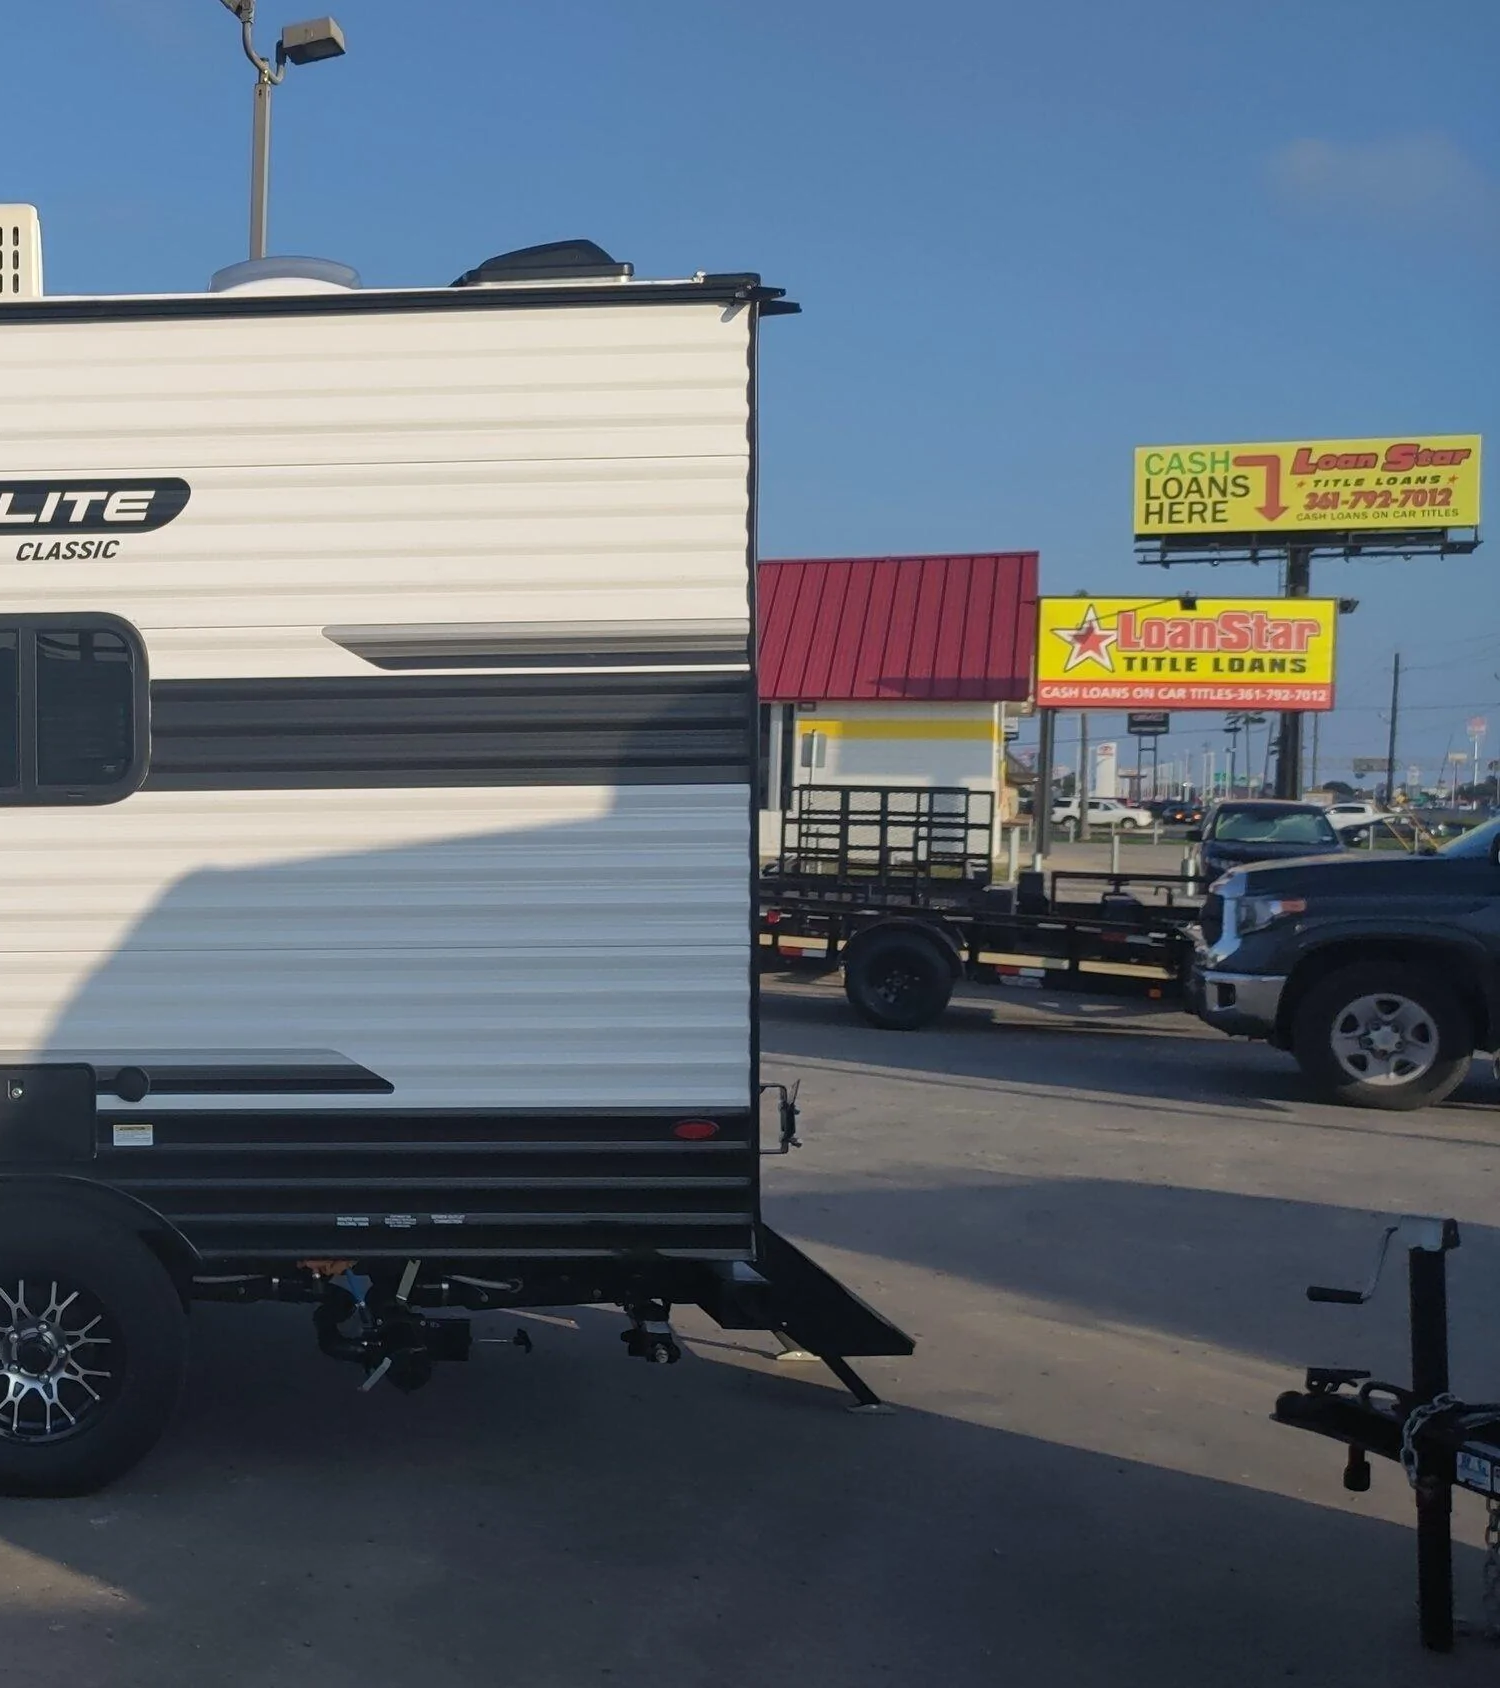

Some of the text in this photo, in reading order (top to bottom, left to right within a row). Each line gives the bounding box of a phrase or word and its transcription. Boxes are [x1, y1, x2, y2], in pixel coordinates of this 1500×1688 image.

[1144, 450, 1230, 476] CASH
[1290, 443, 1472, 475] Loan Star
[1145, 475, 1250, 500] LOANS
[1313, 475, 1442, 488] TITLE LOANS
[1303, 488, 1453, 510] 361-792-7012
[1144, 500, 1229, 525] HERE
[1296, 508, 1459, 522] CASH LOANS ON CAR TITLES
[15, 540, 120, 562] CLASSIC
[1116, 609, 1322, 654] LoanStar
[1122, 656, 1307, 673] TITLE LOANS
[1041, 686, 1079, 699] CASH
[1082, 686, 1130, 699] LOANS
[1132, 687, 1154, 699] ON
[1158, 687, 1186, 699] CAR
